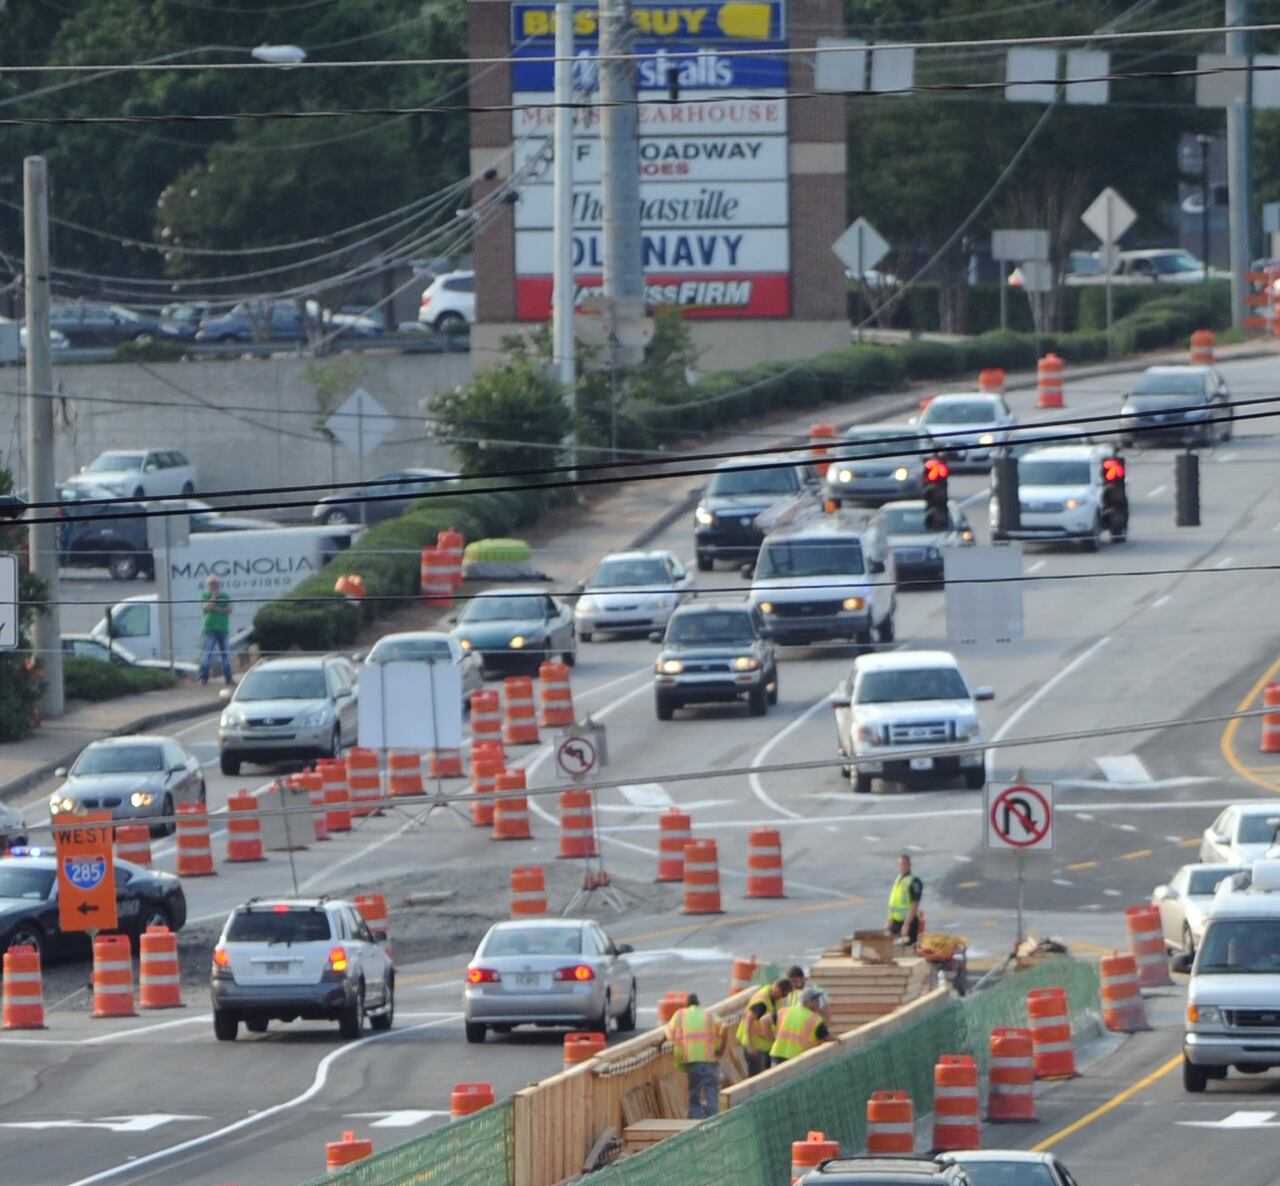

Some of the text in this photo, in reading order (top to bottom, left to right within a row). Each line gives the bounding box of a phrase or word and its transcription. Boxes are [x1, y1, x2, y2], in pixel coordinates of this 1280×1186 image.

[637, 106, 779, 123] EARHOUSE
[640, 142, 763, 160] OADWAY
[641, 235, 743, 266] NAVY
[171, 555, 314, 580] MAGNOLIA
[60, 826, 108, 844] WEST
[72, 865, 101, 882] 285
